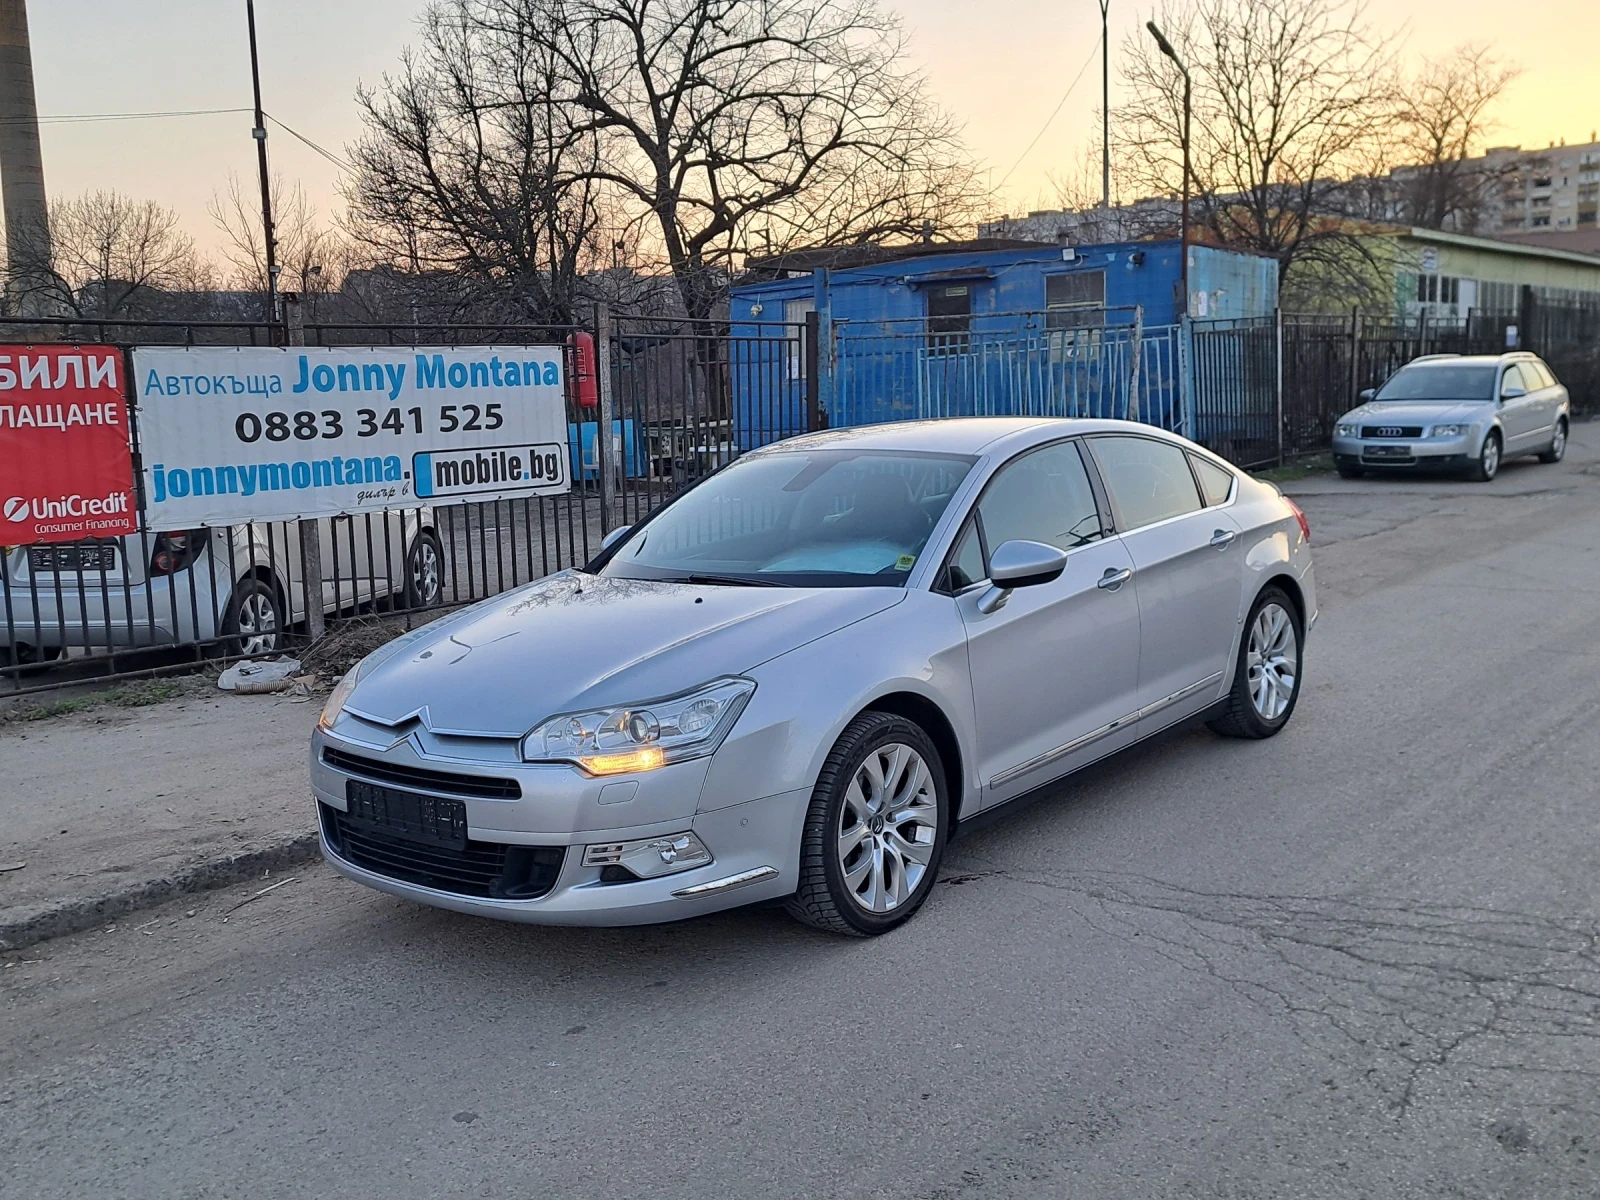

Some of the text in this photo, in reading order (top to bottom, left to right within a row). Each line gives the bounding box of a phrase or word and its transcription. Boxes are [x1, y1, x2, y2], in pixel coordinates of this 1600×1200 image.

[145, 368, 282, 398] Автокъща
[292, 354, 406, 401] Jonny
[415, 354, 559, 390] Montana
[235, 403, 503, 443] 0883 341 525
[435, 449, 558, 488] mobile.bg
[32, 492, 128, 519] UniCredit
[34, 518, 130, 534] Consumer Financing
